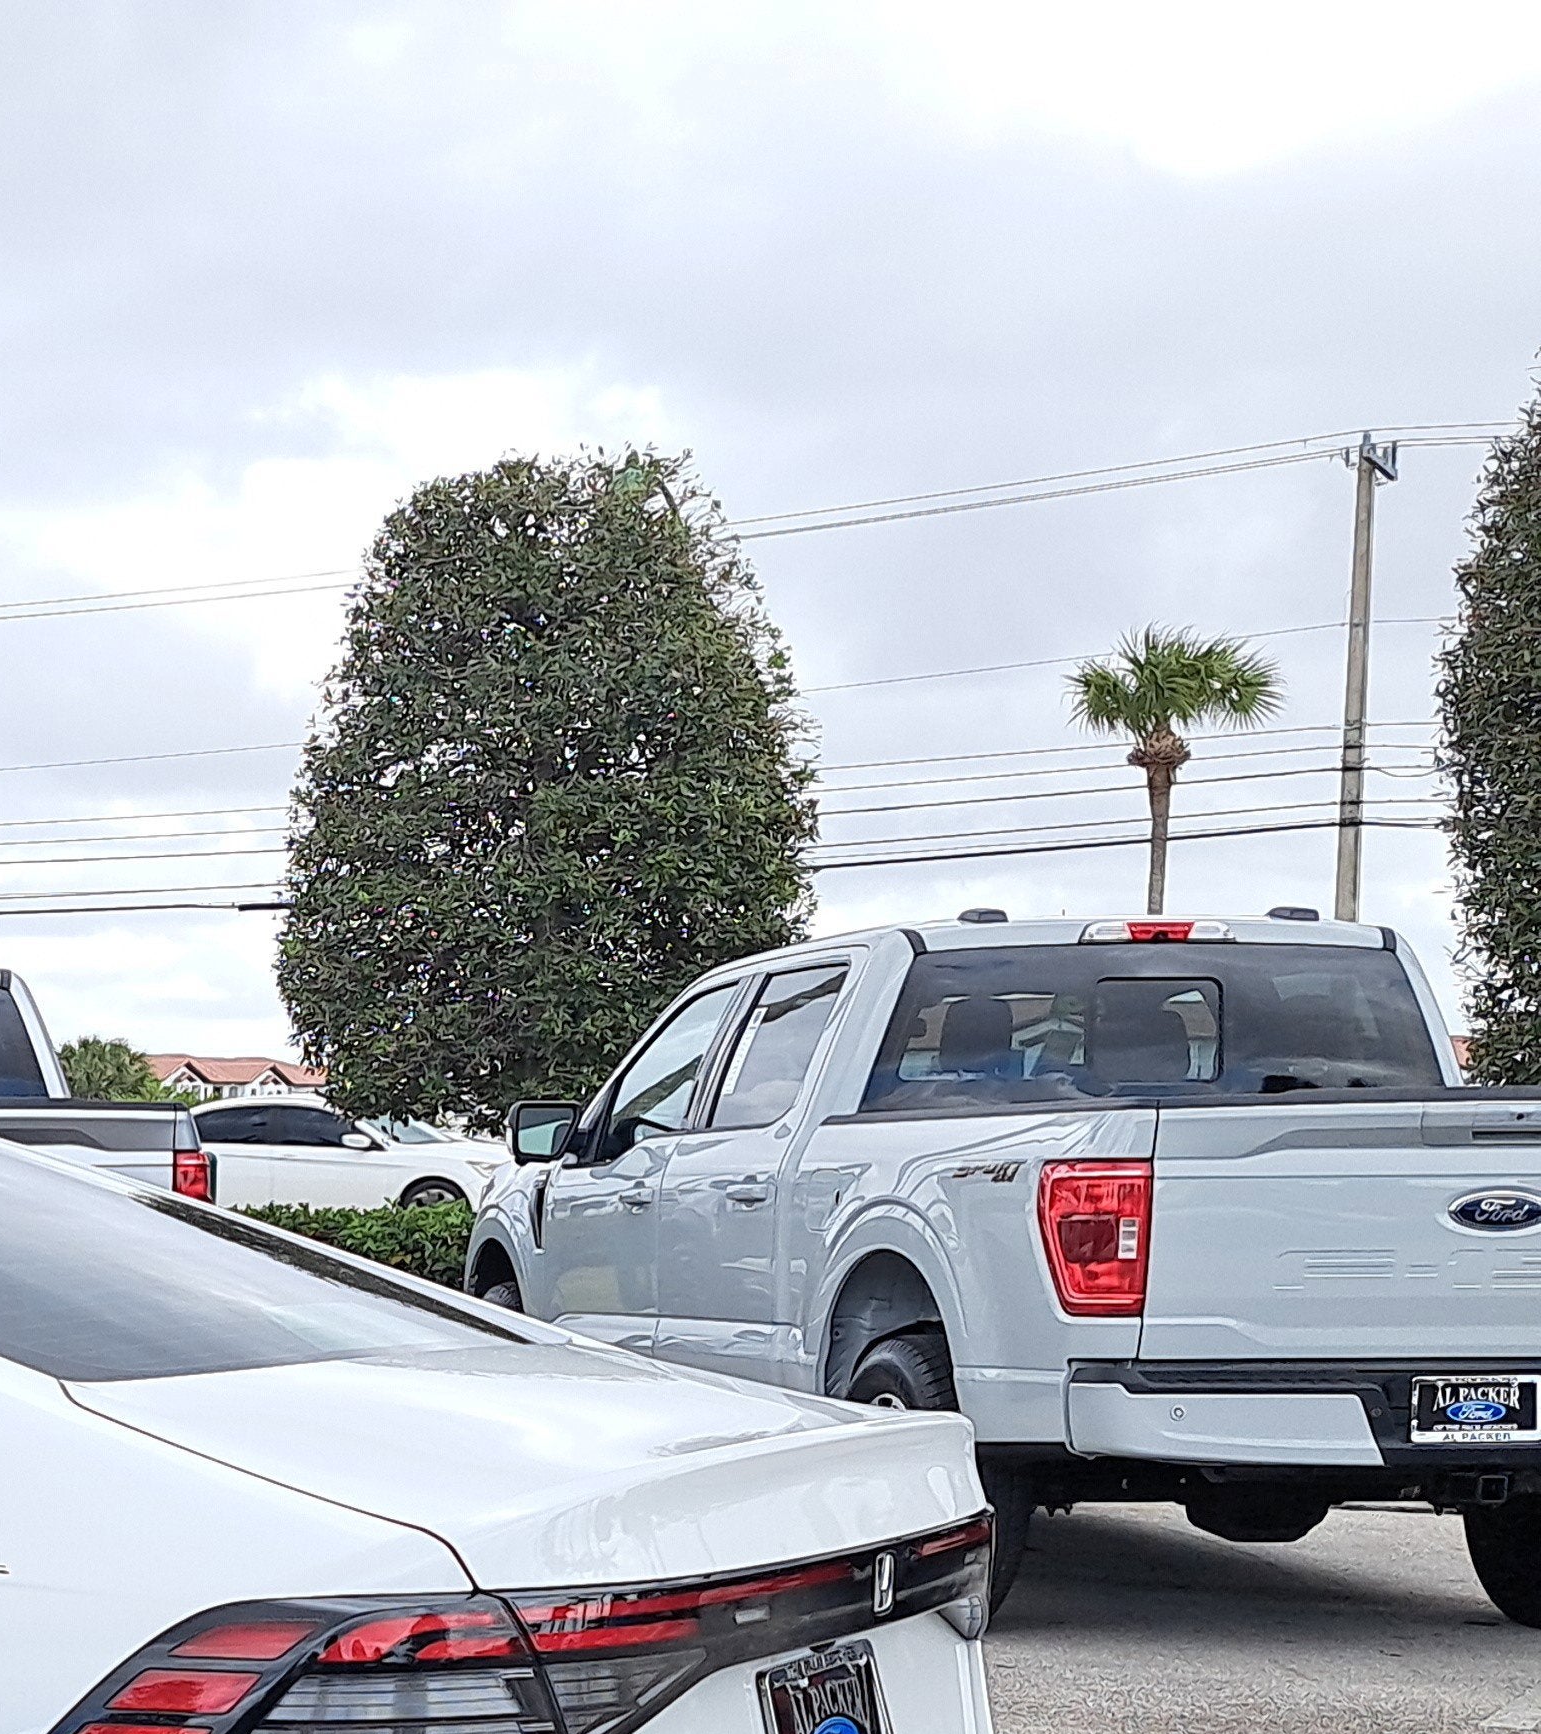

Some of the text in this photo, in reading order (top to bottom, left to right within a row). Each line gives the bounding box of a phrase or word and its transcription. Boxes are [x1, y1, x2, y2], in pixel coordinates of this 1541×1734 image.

[1474, 1198, 1530, 1222] Ford
[1432, 1383, 1521, 1412] AL PACKER
[1458, 1404, 1495, 1420] Ford
